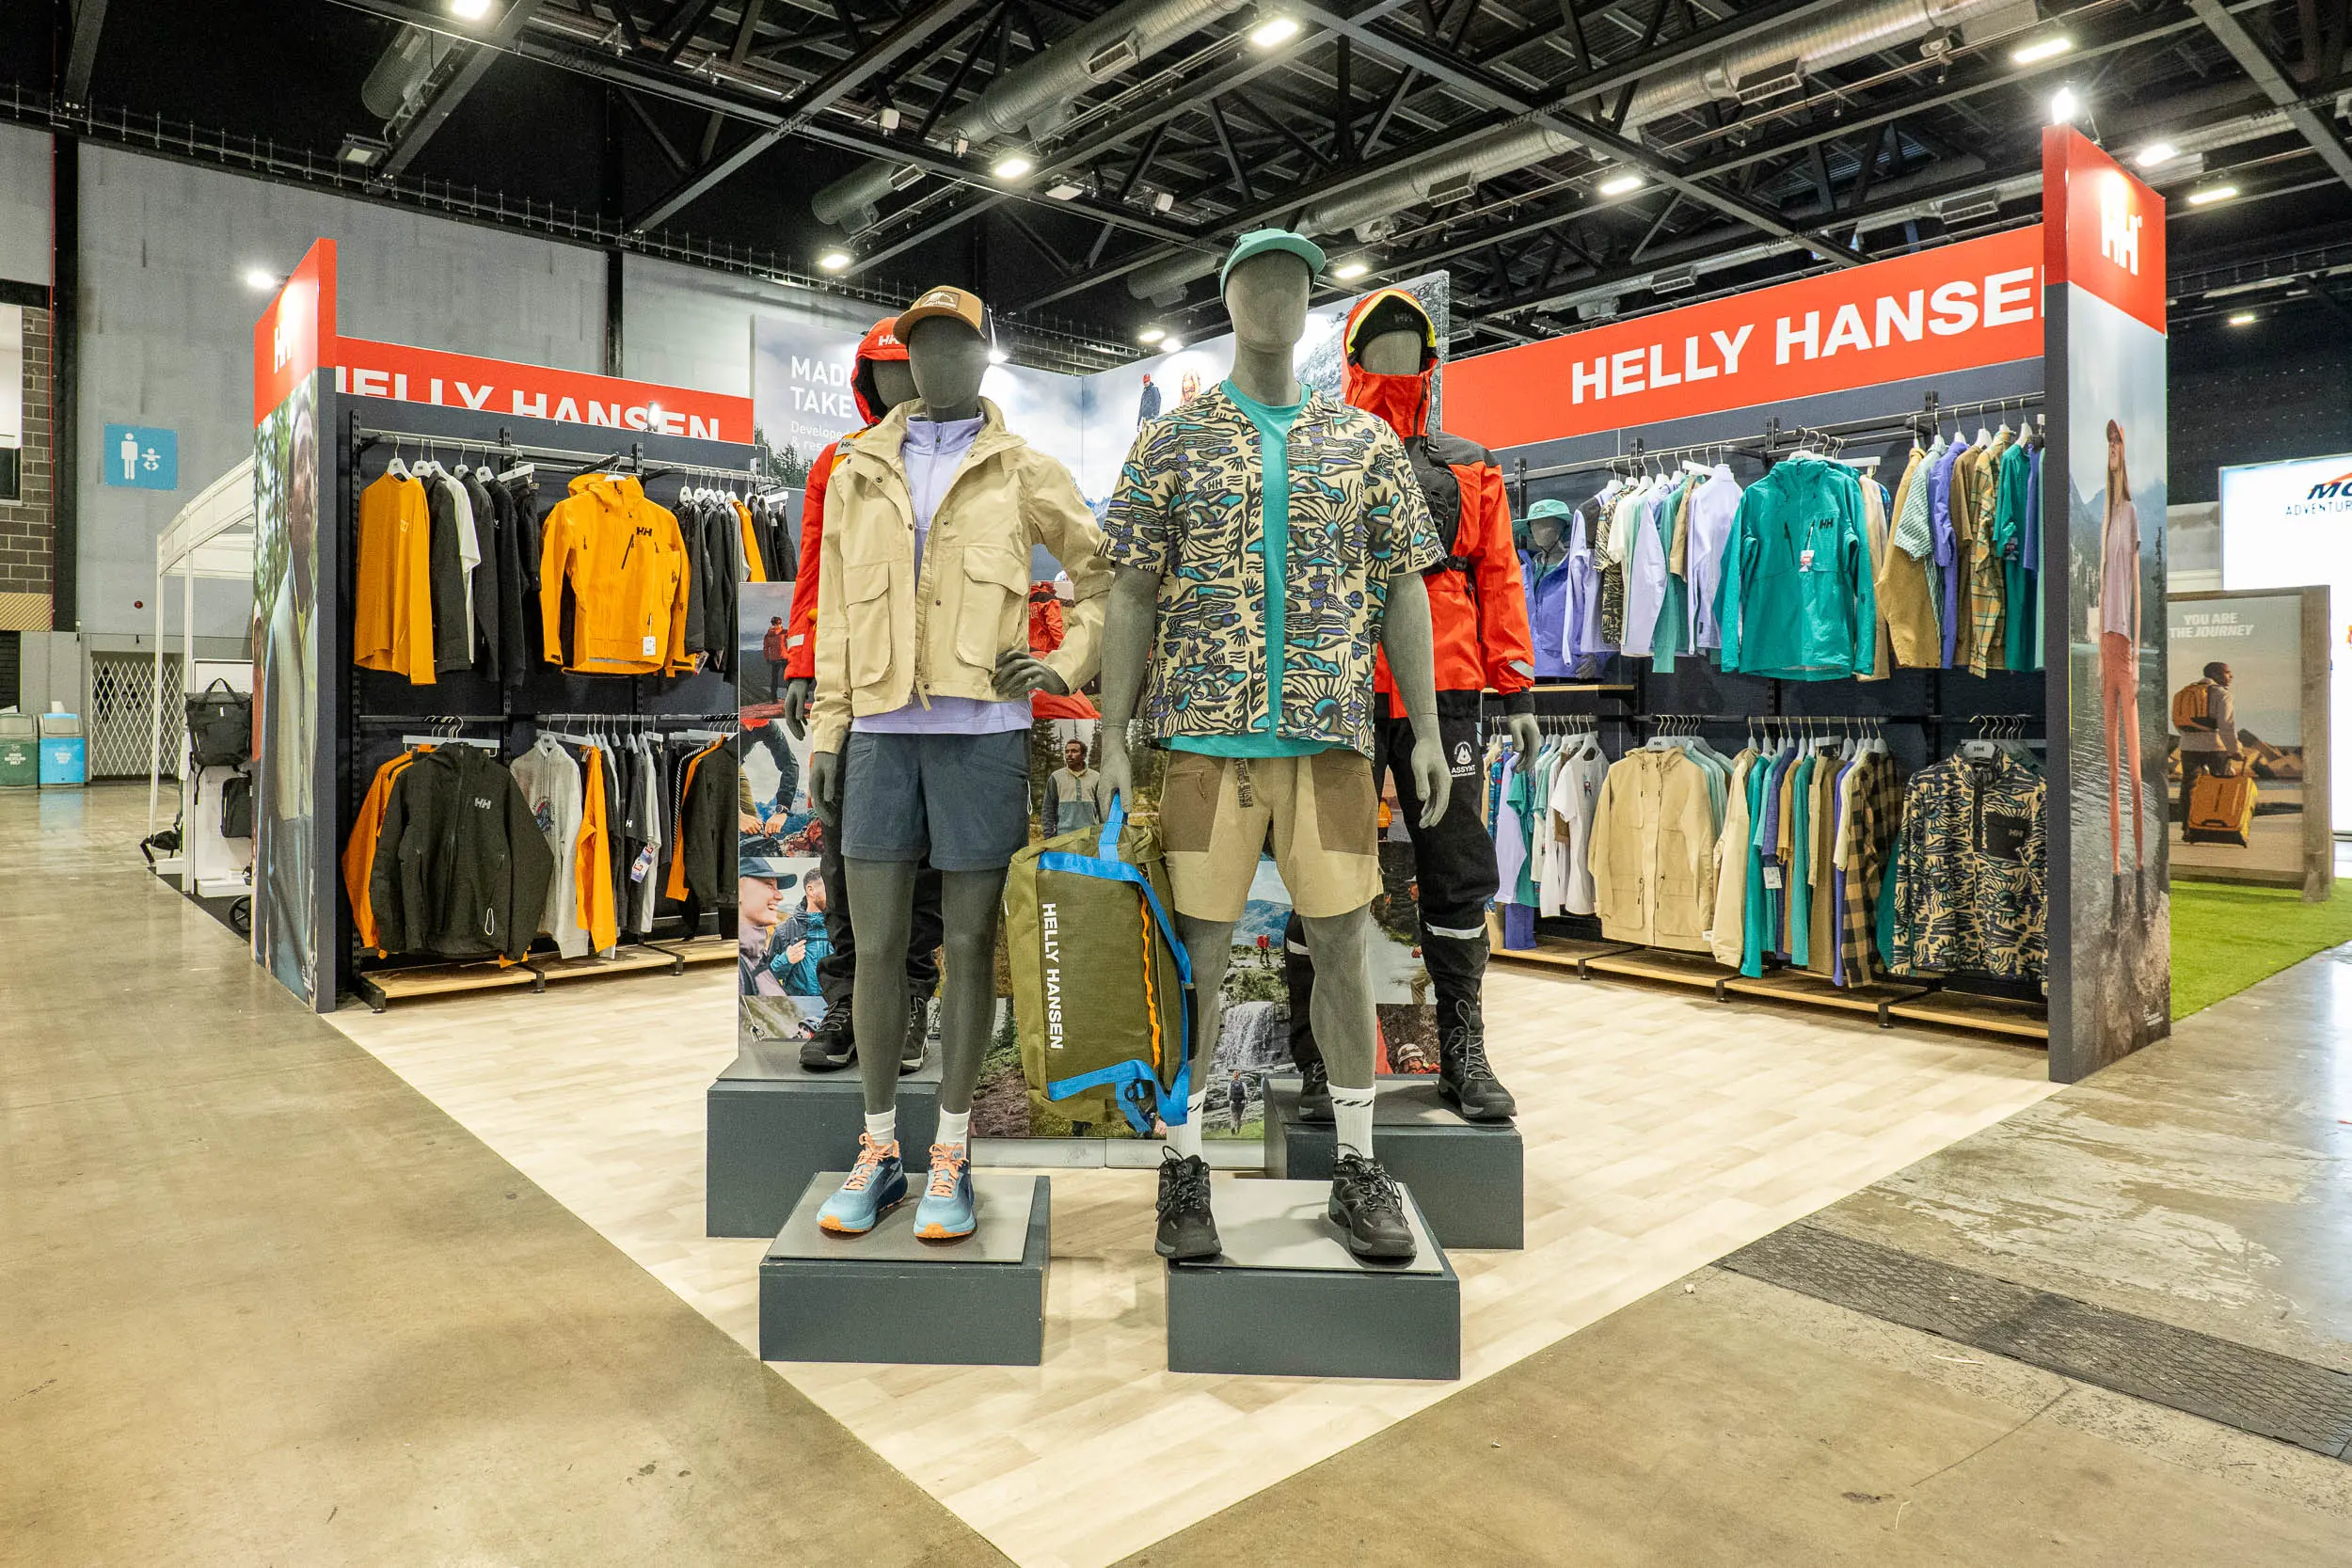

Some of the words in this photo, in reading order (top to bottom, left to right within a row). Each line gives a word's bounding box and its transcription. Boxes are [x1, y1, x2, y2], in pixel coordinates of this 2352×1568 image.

[1572, 324, 1755, 404] HELLY
[1775, 264, 2044, 365] HANSE
[791, 356, 853, 388] MAD
[790, 386, 852, 419] TAKE
[1207, 478, 1223, 490] HH
[1820, 517, 1834, 530] HH
[637, 526, 653, 537] HH
[1424, 547, 1438, 561] HH
[2184, 614, 2209, 626] YOU
[2212, 612, 2238, 625] ARE
[2169, 626, 2194, 639] THE
[2195, 624, 2254, 638] JOURNEY
[1451, 764, 1476, 774] ASSYNT
[474, 797, 492, 810] HH
[2009, 829, 2025, 837] HH
[1041, 902, 1059, 963] HELLY
[1046, 968, 1064, 1050] HANSEN
